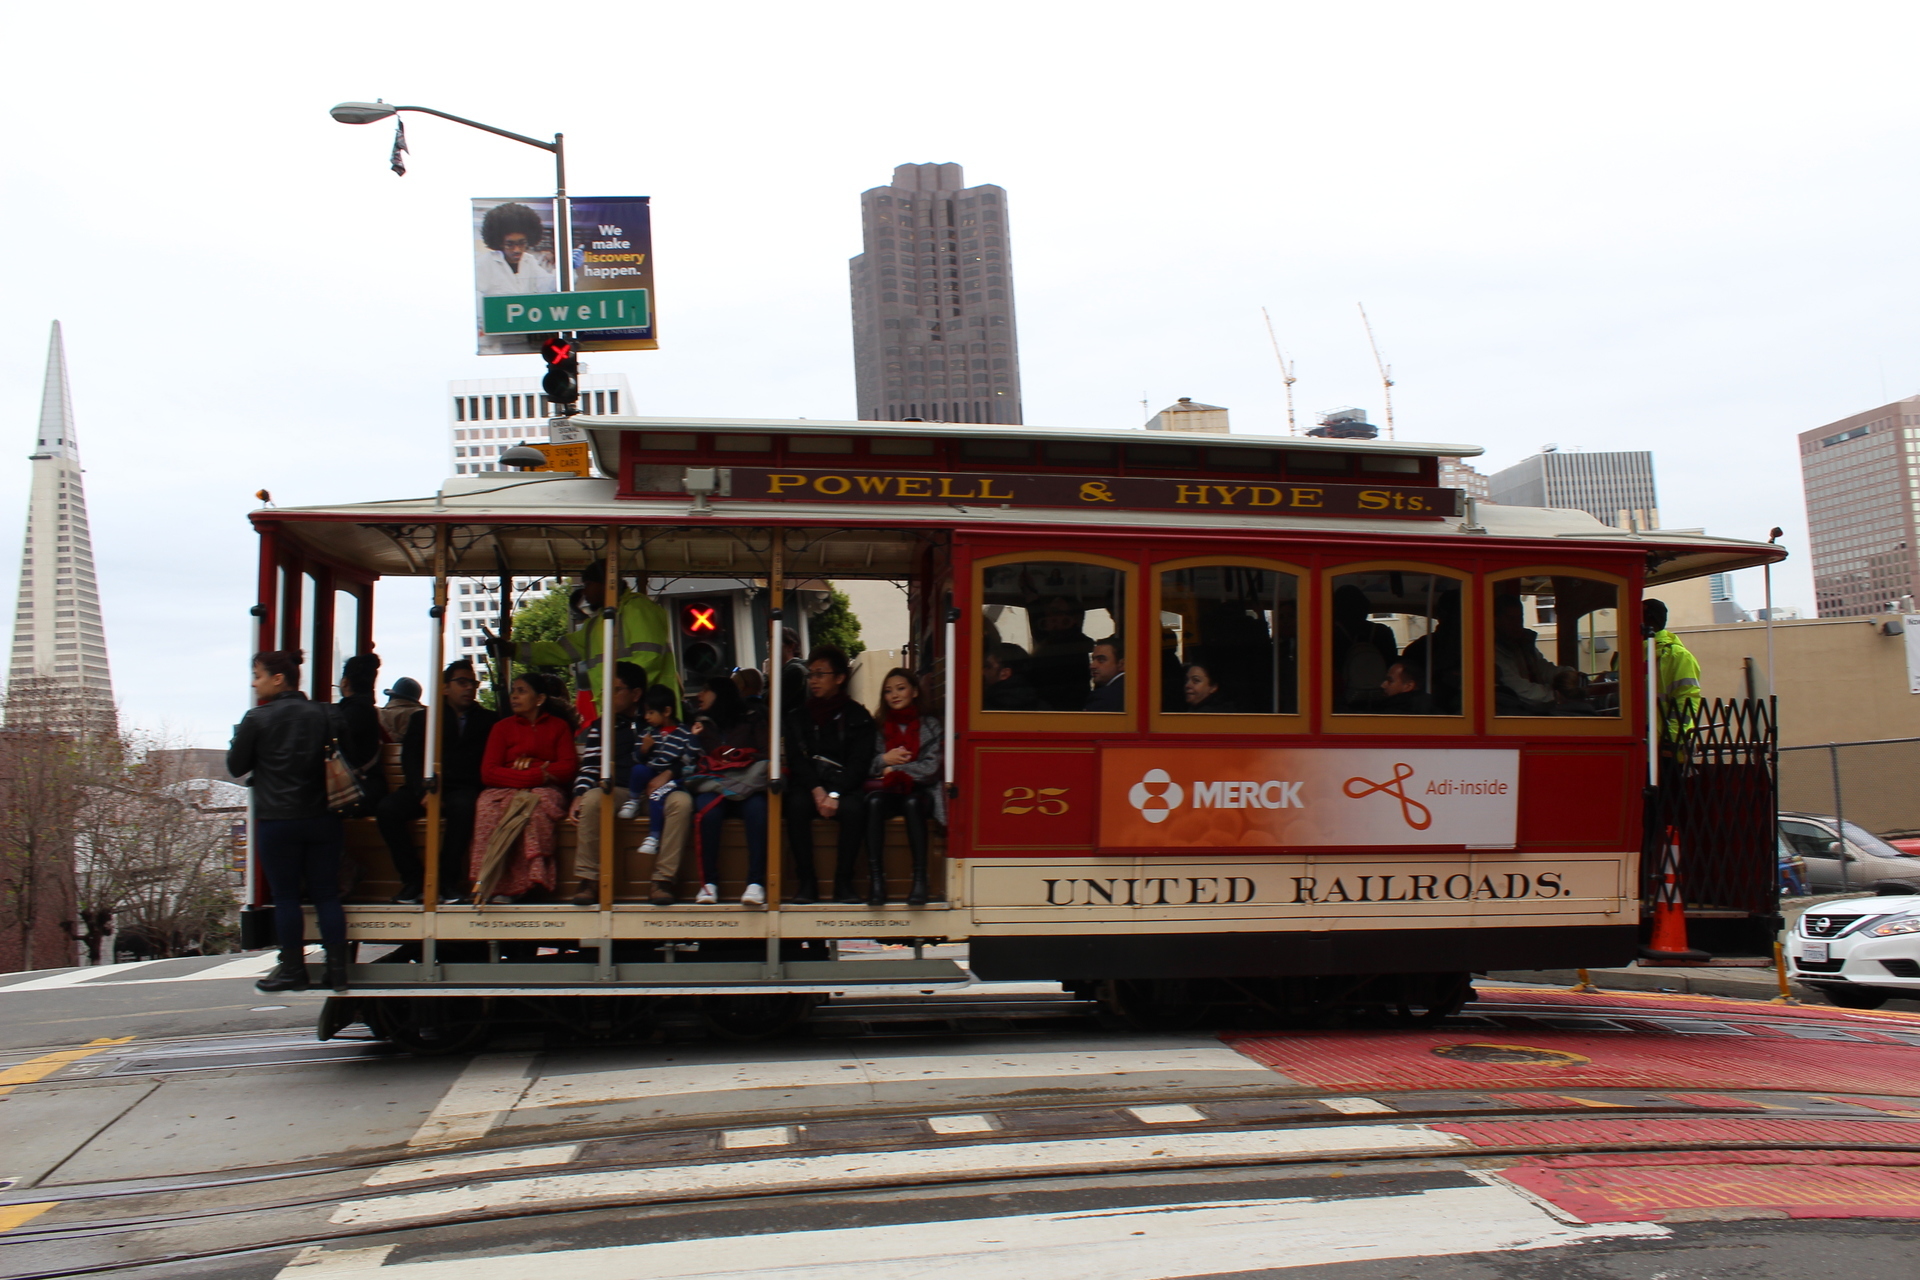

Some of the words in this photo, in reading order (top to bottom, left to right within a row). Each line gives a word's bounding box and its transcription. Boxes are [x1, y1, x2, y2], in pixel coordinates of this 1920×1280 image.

[598, 224, 622, 236] We
[592, 237, 631, 249] make
[584, 264, 641, 279] happen.
[506, 300, 624, 323] Powell
[766, 474, 1014, 499] POWELL
[1079, 481, 1116, 502] &
[1176, 485, 1323, 508] HYDE
[1357, 490, 1433, 511] Sts.
[1192, 780, 1306, 810] MERCK
[1425, 777, 1508, 797] Adi-inside
[1001, 786, 1071, 816] 25
[1043, 877, 1256, 906] UNITED
[1290, 871, 1571, 904] RAILROADS.
[643, 920, 663, 928] TWO
[665, 920, 714, 928] STANDEES
[716, 920, 740, 928] ONLY
[816, 920, 836, 928] TWO
[838, 919, 886, 928] STANDEES
[888, 919, 911, 927] ONLY
